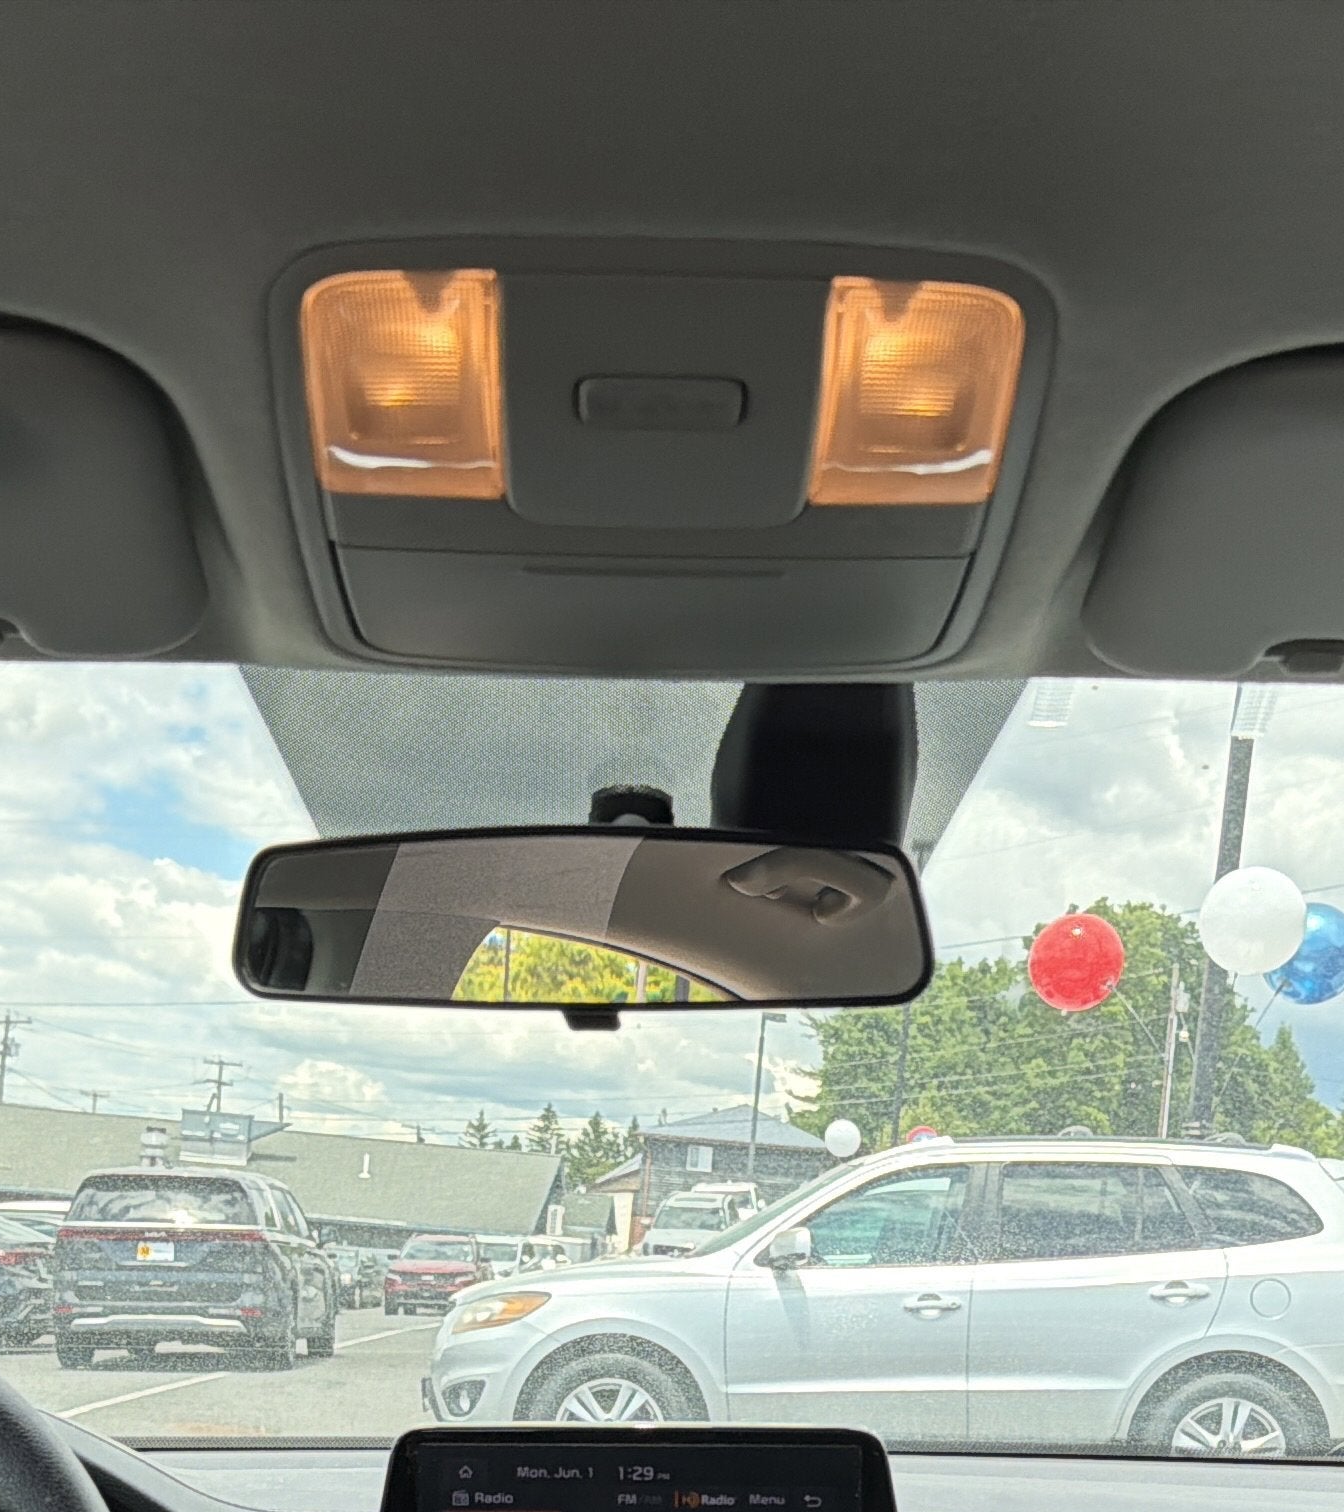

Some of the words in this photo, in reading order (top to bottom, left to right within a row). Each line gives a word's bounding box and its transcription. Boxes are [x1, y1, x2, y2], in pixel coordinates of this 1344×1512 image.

[516, 1466, 552, 1479] Mon.
[554, 1466, 584, 1479] Jun.
[587, 1466, 595, 1479] 1
[617, 1466, 655, 1481] 1:29
[474, 1491, 514, 1504] Radio
[748, 1493, 787, 1506] Menu
